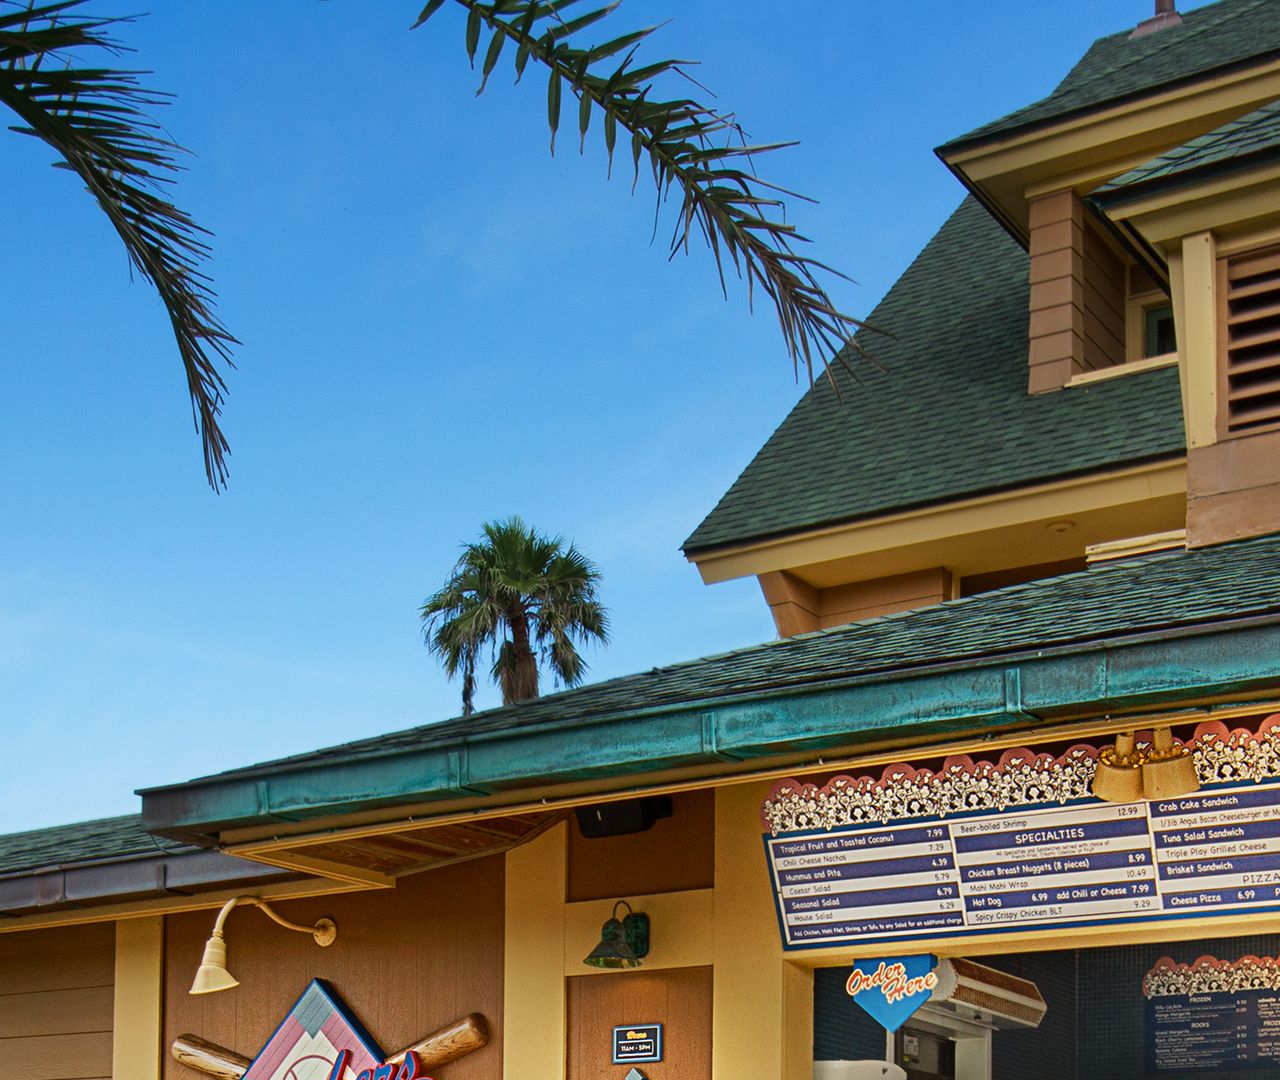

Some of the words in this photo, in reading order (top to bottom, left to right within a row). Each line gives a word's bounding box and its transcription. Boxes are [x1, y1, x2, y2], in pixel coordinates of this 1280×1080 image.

[1159, 803, 1177, 812] Crab
[1181, 800, 1200, 810] Cake
[1202, 796, 1239, 808] Sandwich
[960, 823, 1000, 833] Beer-boiled
[1003, 820, 1027, 829] Shrimp
[1118, 807, 1137, 816] 12.99
[1180, 816, 1197, 827] Angus
[1200, 815, 1217, 823] Bacon
[1220, 811, 1261, 823] Cheeseburger
[780, 844, 806, 854] Tropical
[840, 837, 865, 847] Toasted
[868, 835, 894, 844] Coconut
[927, 829, 943, 838] 7.99
[1015, 828, 1084, 844] SPECIALTIES
[1162, 834, 1181, 843] Tuna
[1184, 831, 1206, 841] Salad
[1208, 828, 1244, 839] Sandwich
[783, 859, 797, 867] Chili
[799, 857, 821, 865] Cheese
[823, 854, 846, 862] Nachos
[1166, 849, 1188, 859] Triple
[1191, 847, 1208, 857] Play
[1210, 844, 1236, 854] Grilled
[1239, 842, 1267, 851] Cheese
[786, 873, 812, 881] Hummus
[814, 871, 825, 879] and
[932, 859, 948, 867] 4.39
[968, 869, 995, 878] Chicken
[997, 866, 1019, 876] Breast
[1022, 863, 1051, 875] Nuggets
[1064, 858, 1090, 870] pieces)
[1128, 853, 1145, 863] 8.99
[1167, 865, 1194, 875] Brisket
[1197, 862, 1233, 872] Sandwich
[790, 887, 811, 895] Caesar
[935, 873, 949, 881] 5.79
[970, 884, 986, 892] Mahi
[989, 882, 1006, 890] Mahi
[1009, 881, 1028, 889] Wrap
[1126, 869, 1146, 878] 10.49
[1243, 873, 1280, 884] PIZZA
[792, 900, 819, 909] Seasonal
[822, 898, 840, 906] Salad
[937, 888, 952, 896] 6.79
[973, 899, 985, 907] Hot
[988, 897, 1001, 907] Dog
[1032, 893, 1047, 902] 6.99
[1072, 889, 1088, 898] Chili
[1100, 888, 1127, 896] Cheese
[1132, 885, 1149, 893] 7.99
[1171, 897, 1197, 906] Cheese
[1200, 894, 1221, 903] Pizza
[1237, 891, 1255, 900] 6.99
[794, 914, 812, 922] House
[816, 912, 833, 920] Salad
[940, 902, 954, 910] 6.29
[975, 912, 993, 922] Spicy
[996, 910, 1018, 920] Crispy
[1020, 908, 1047, 917] Chicken
[1050, 907, 1062, 915] BLT
[1134, 900, 1150, 908] 9.29
[846, 962, 906, 996] Order
[881, 972, 938, 1004] Here
